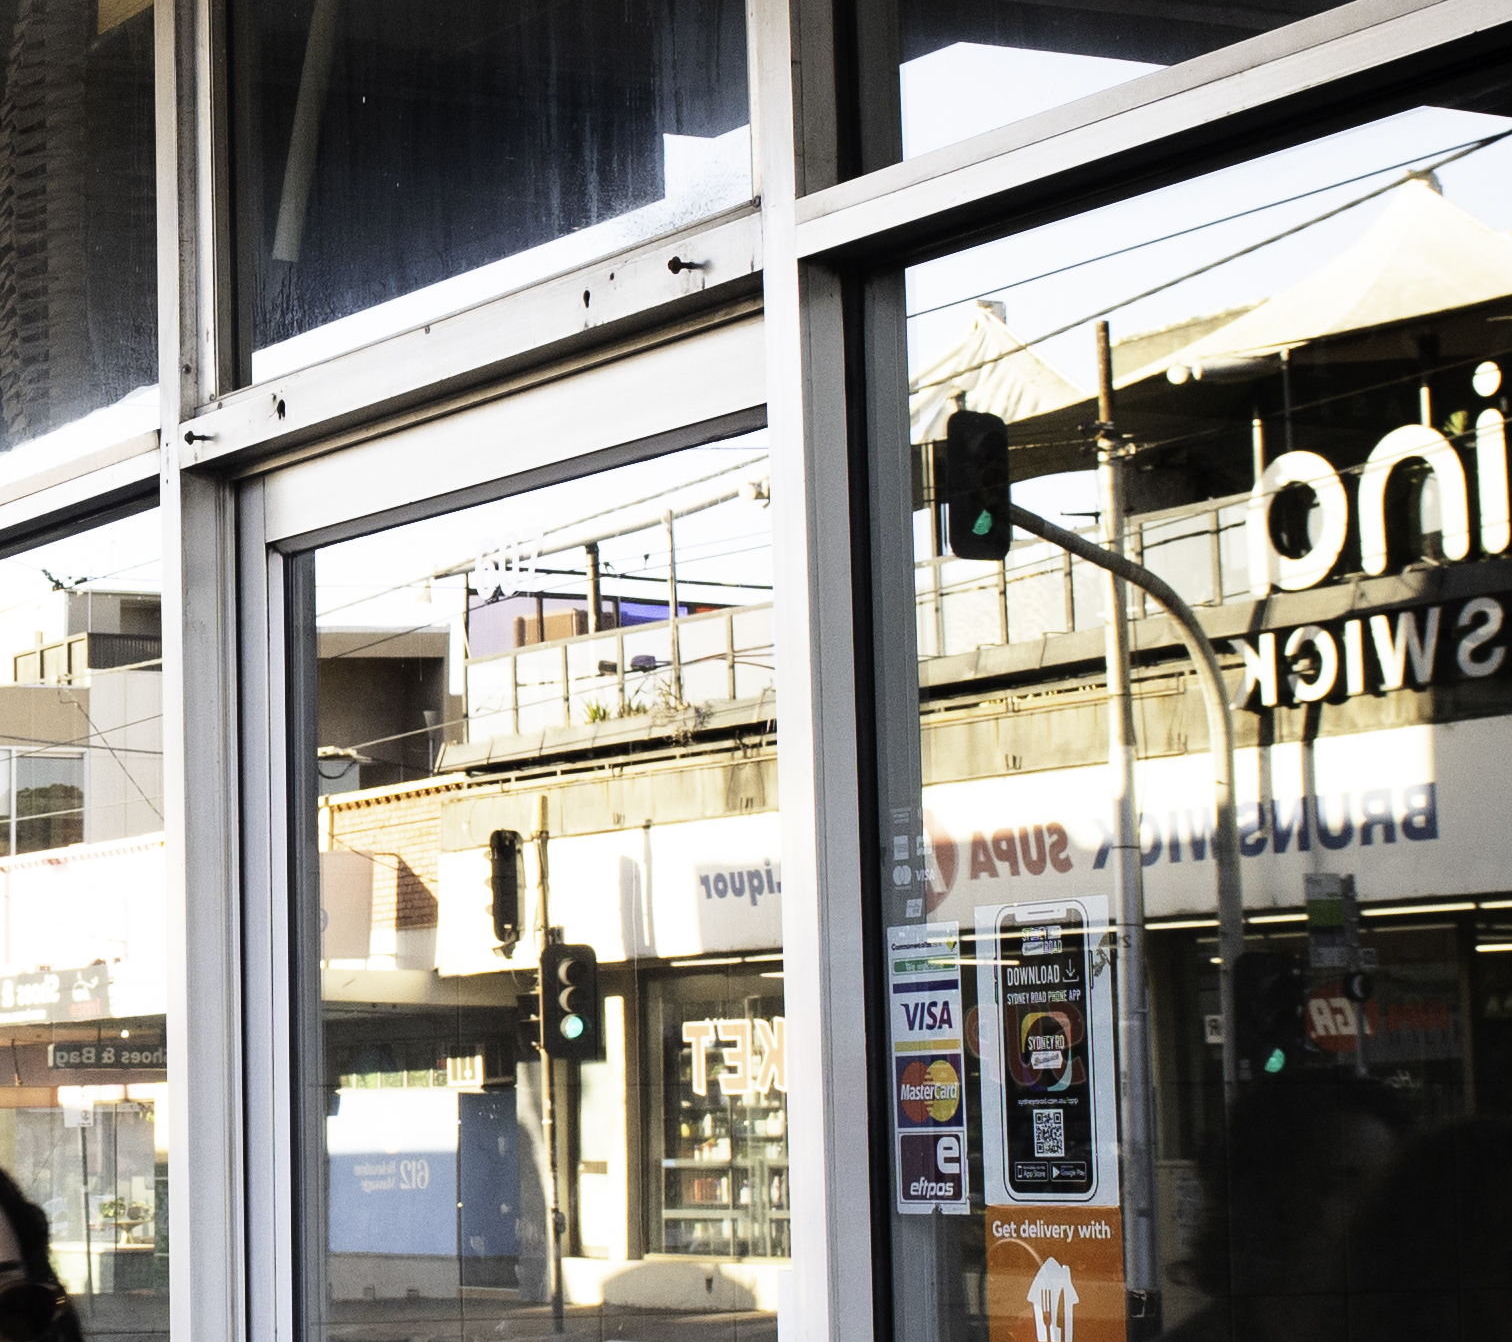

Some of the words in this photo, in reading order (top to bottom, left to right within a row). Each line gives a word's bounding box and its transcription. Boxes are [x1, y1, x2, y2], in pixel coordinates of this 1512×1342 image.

[1006, 964, 1060, 986] DOWNLOAD
[1007, 992, 1029, 1005] SYDNEY
[1030, 991, 1047, 1004] ROAD
[1068, 989, 1080, 1001] APP
[900, 999, 954, 1031] VISA
[900, 1082, 958, 1102] MasterCard
[909, 1177, 954, 1199] eftpos
[992, 1219, 1017, 1239] Get
[1019, 1219, 1074, 1243] delivery
[1078, 1220, 1111, 1239] with
